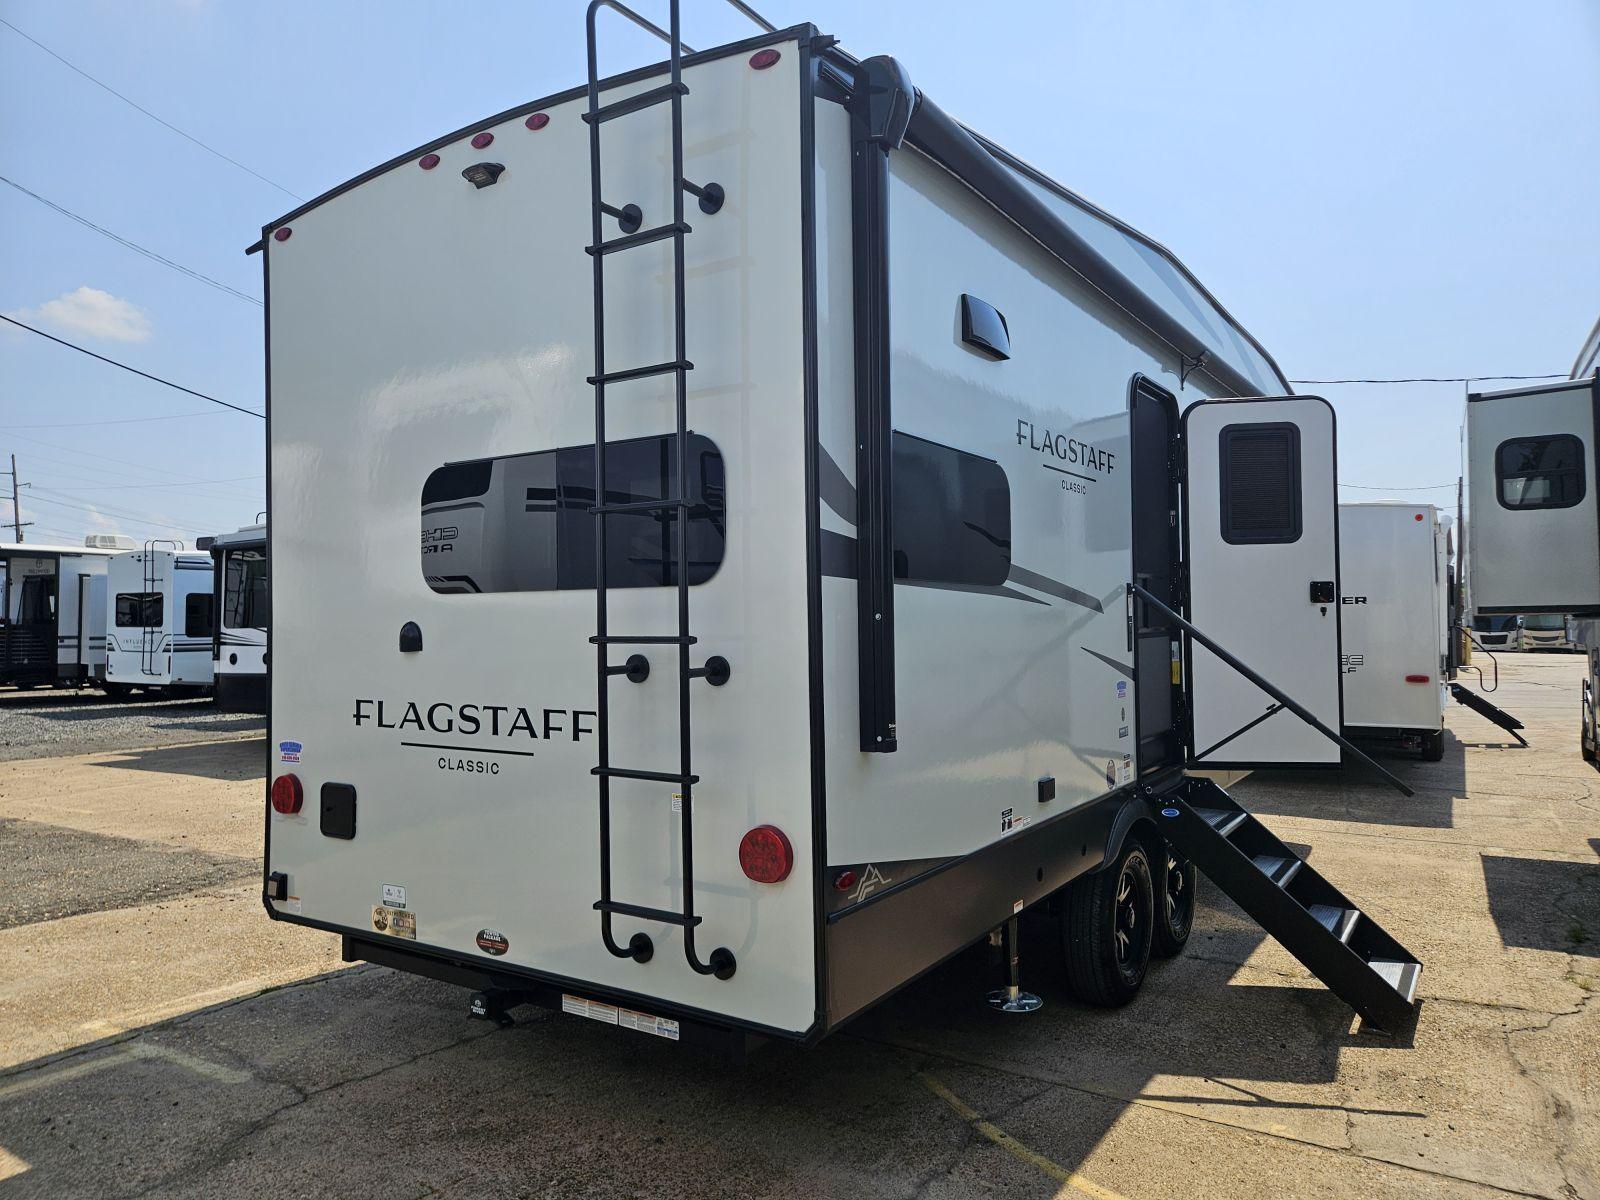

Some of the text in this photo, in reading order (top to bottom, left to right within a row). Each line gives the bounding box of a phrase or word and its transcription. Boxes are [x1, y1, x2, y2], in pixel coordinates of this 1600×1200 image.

[1016, 418, 1115, 474] FLAGSTAFF
[1061, 479, 1087, 495] CLASSIC
[353, 699, 597, 742] FLAGSTAFF
[438, 757, 500, 775] CLASSIC
